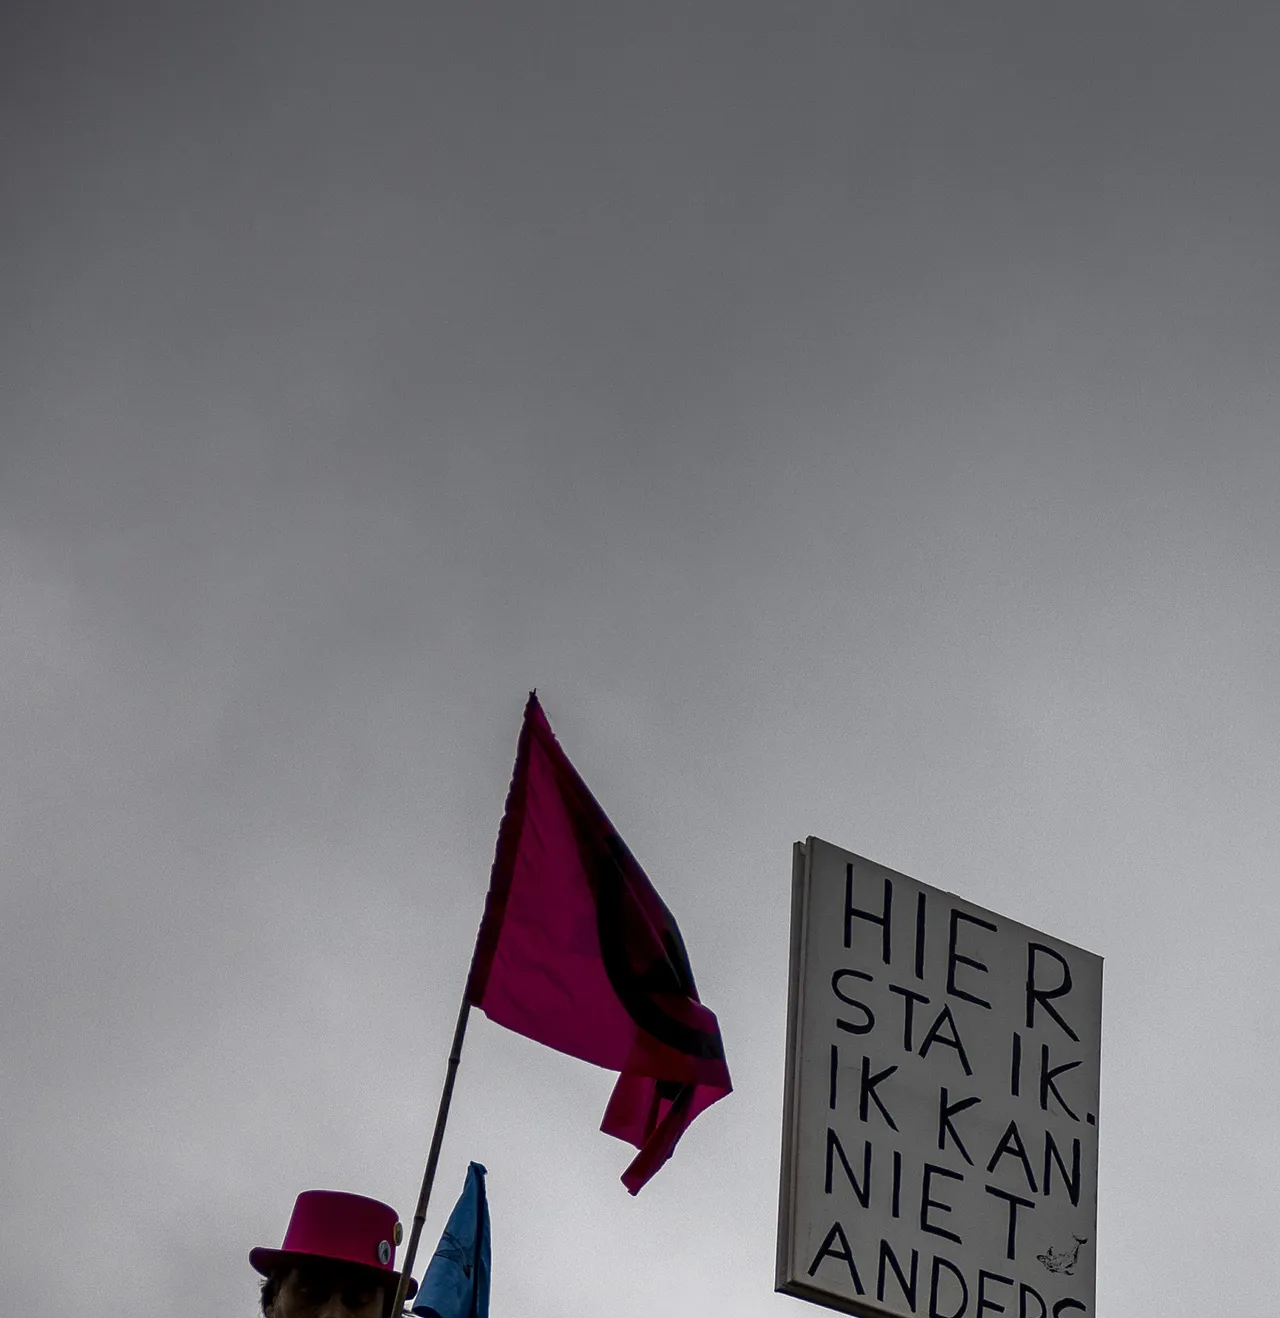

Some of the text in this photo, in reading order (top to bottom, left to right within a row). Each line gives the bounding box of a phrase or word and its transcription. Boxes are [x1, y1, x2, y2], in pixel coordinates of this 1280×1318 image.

[842, 862, 1080, 1043] HIER
[828, 1043, 1081, 1208] IK KAN
[830, 968, 1097, 1127] STA IK.
[824, 1126, 1036, 1261] NIET
